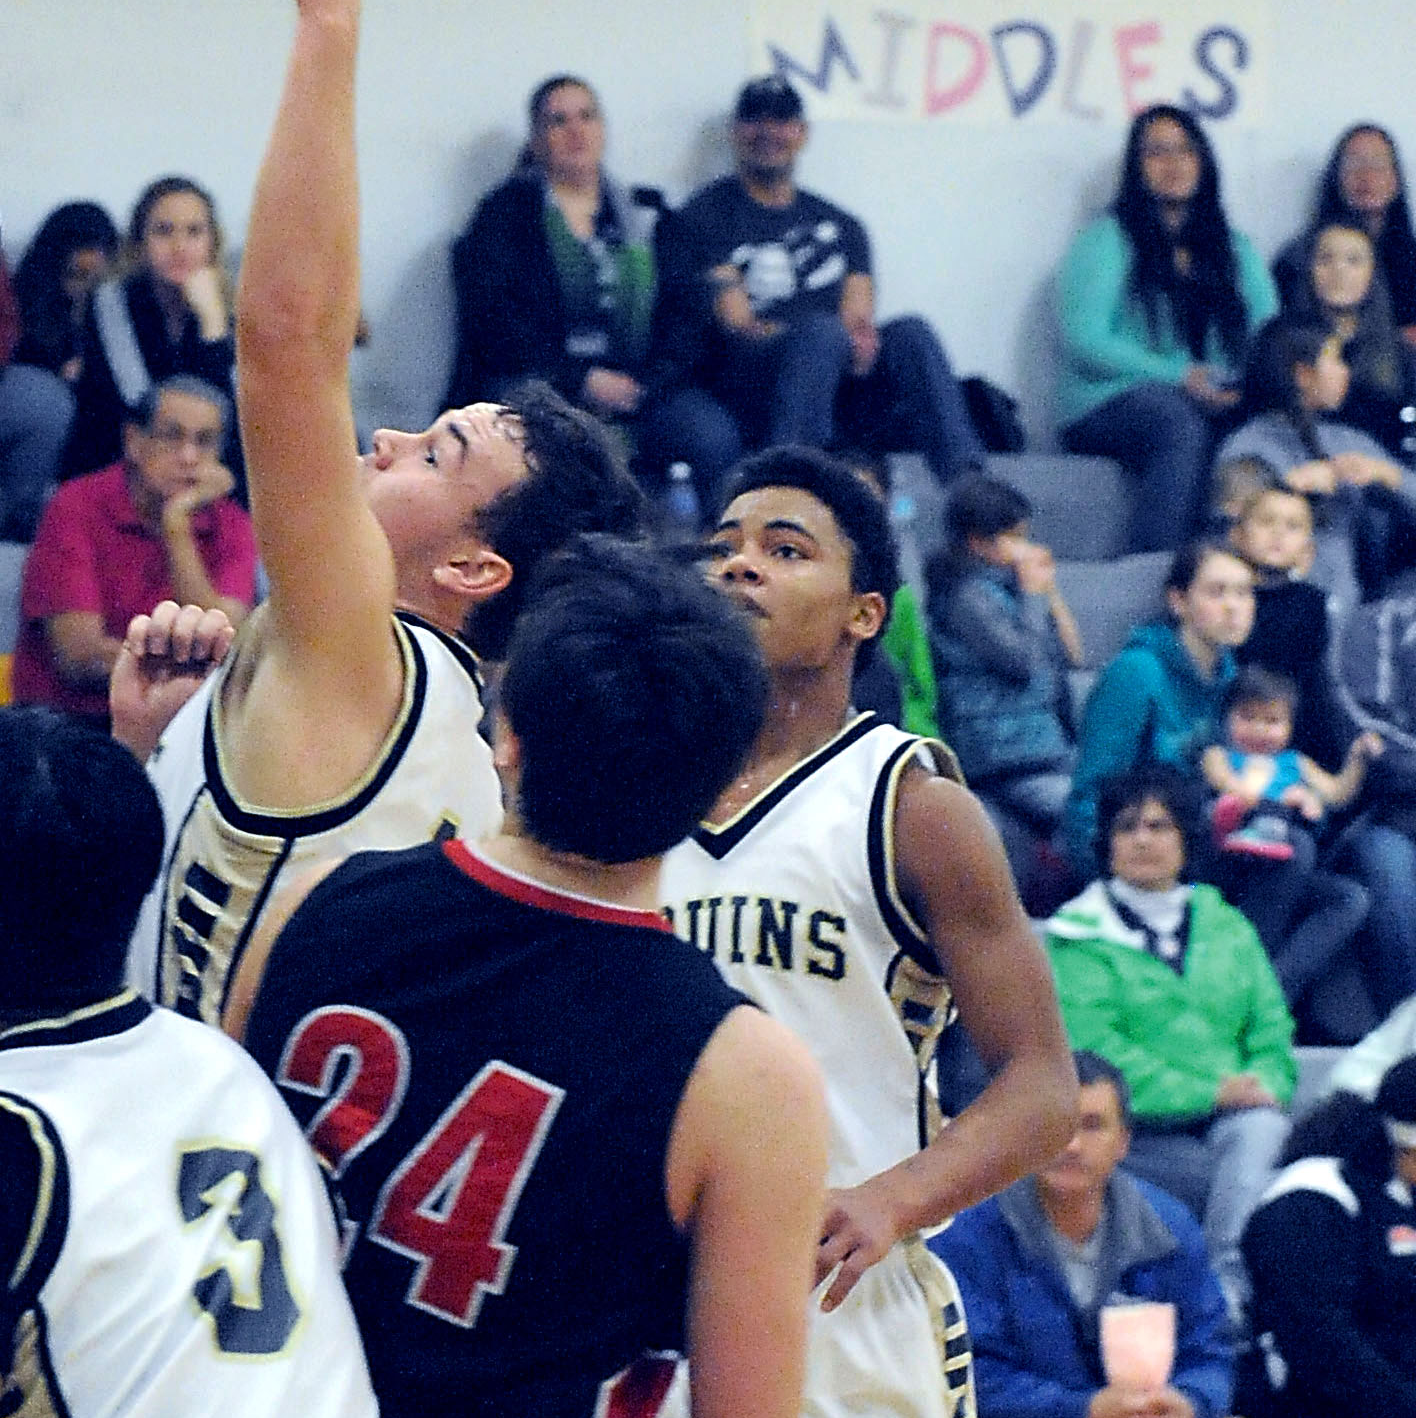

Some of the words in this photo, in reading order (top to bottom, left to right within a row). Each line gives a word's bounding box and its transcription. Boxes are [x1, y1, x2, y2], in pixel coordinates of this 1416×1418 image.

[767, 13, 1249, 120] MIDDLES
[663, 893, 848, 982] UINS
[177, 1136, 303, 1364] 3
[275, 1004, 567, 1329] 24
